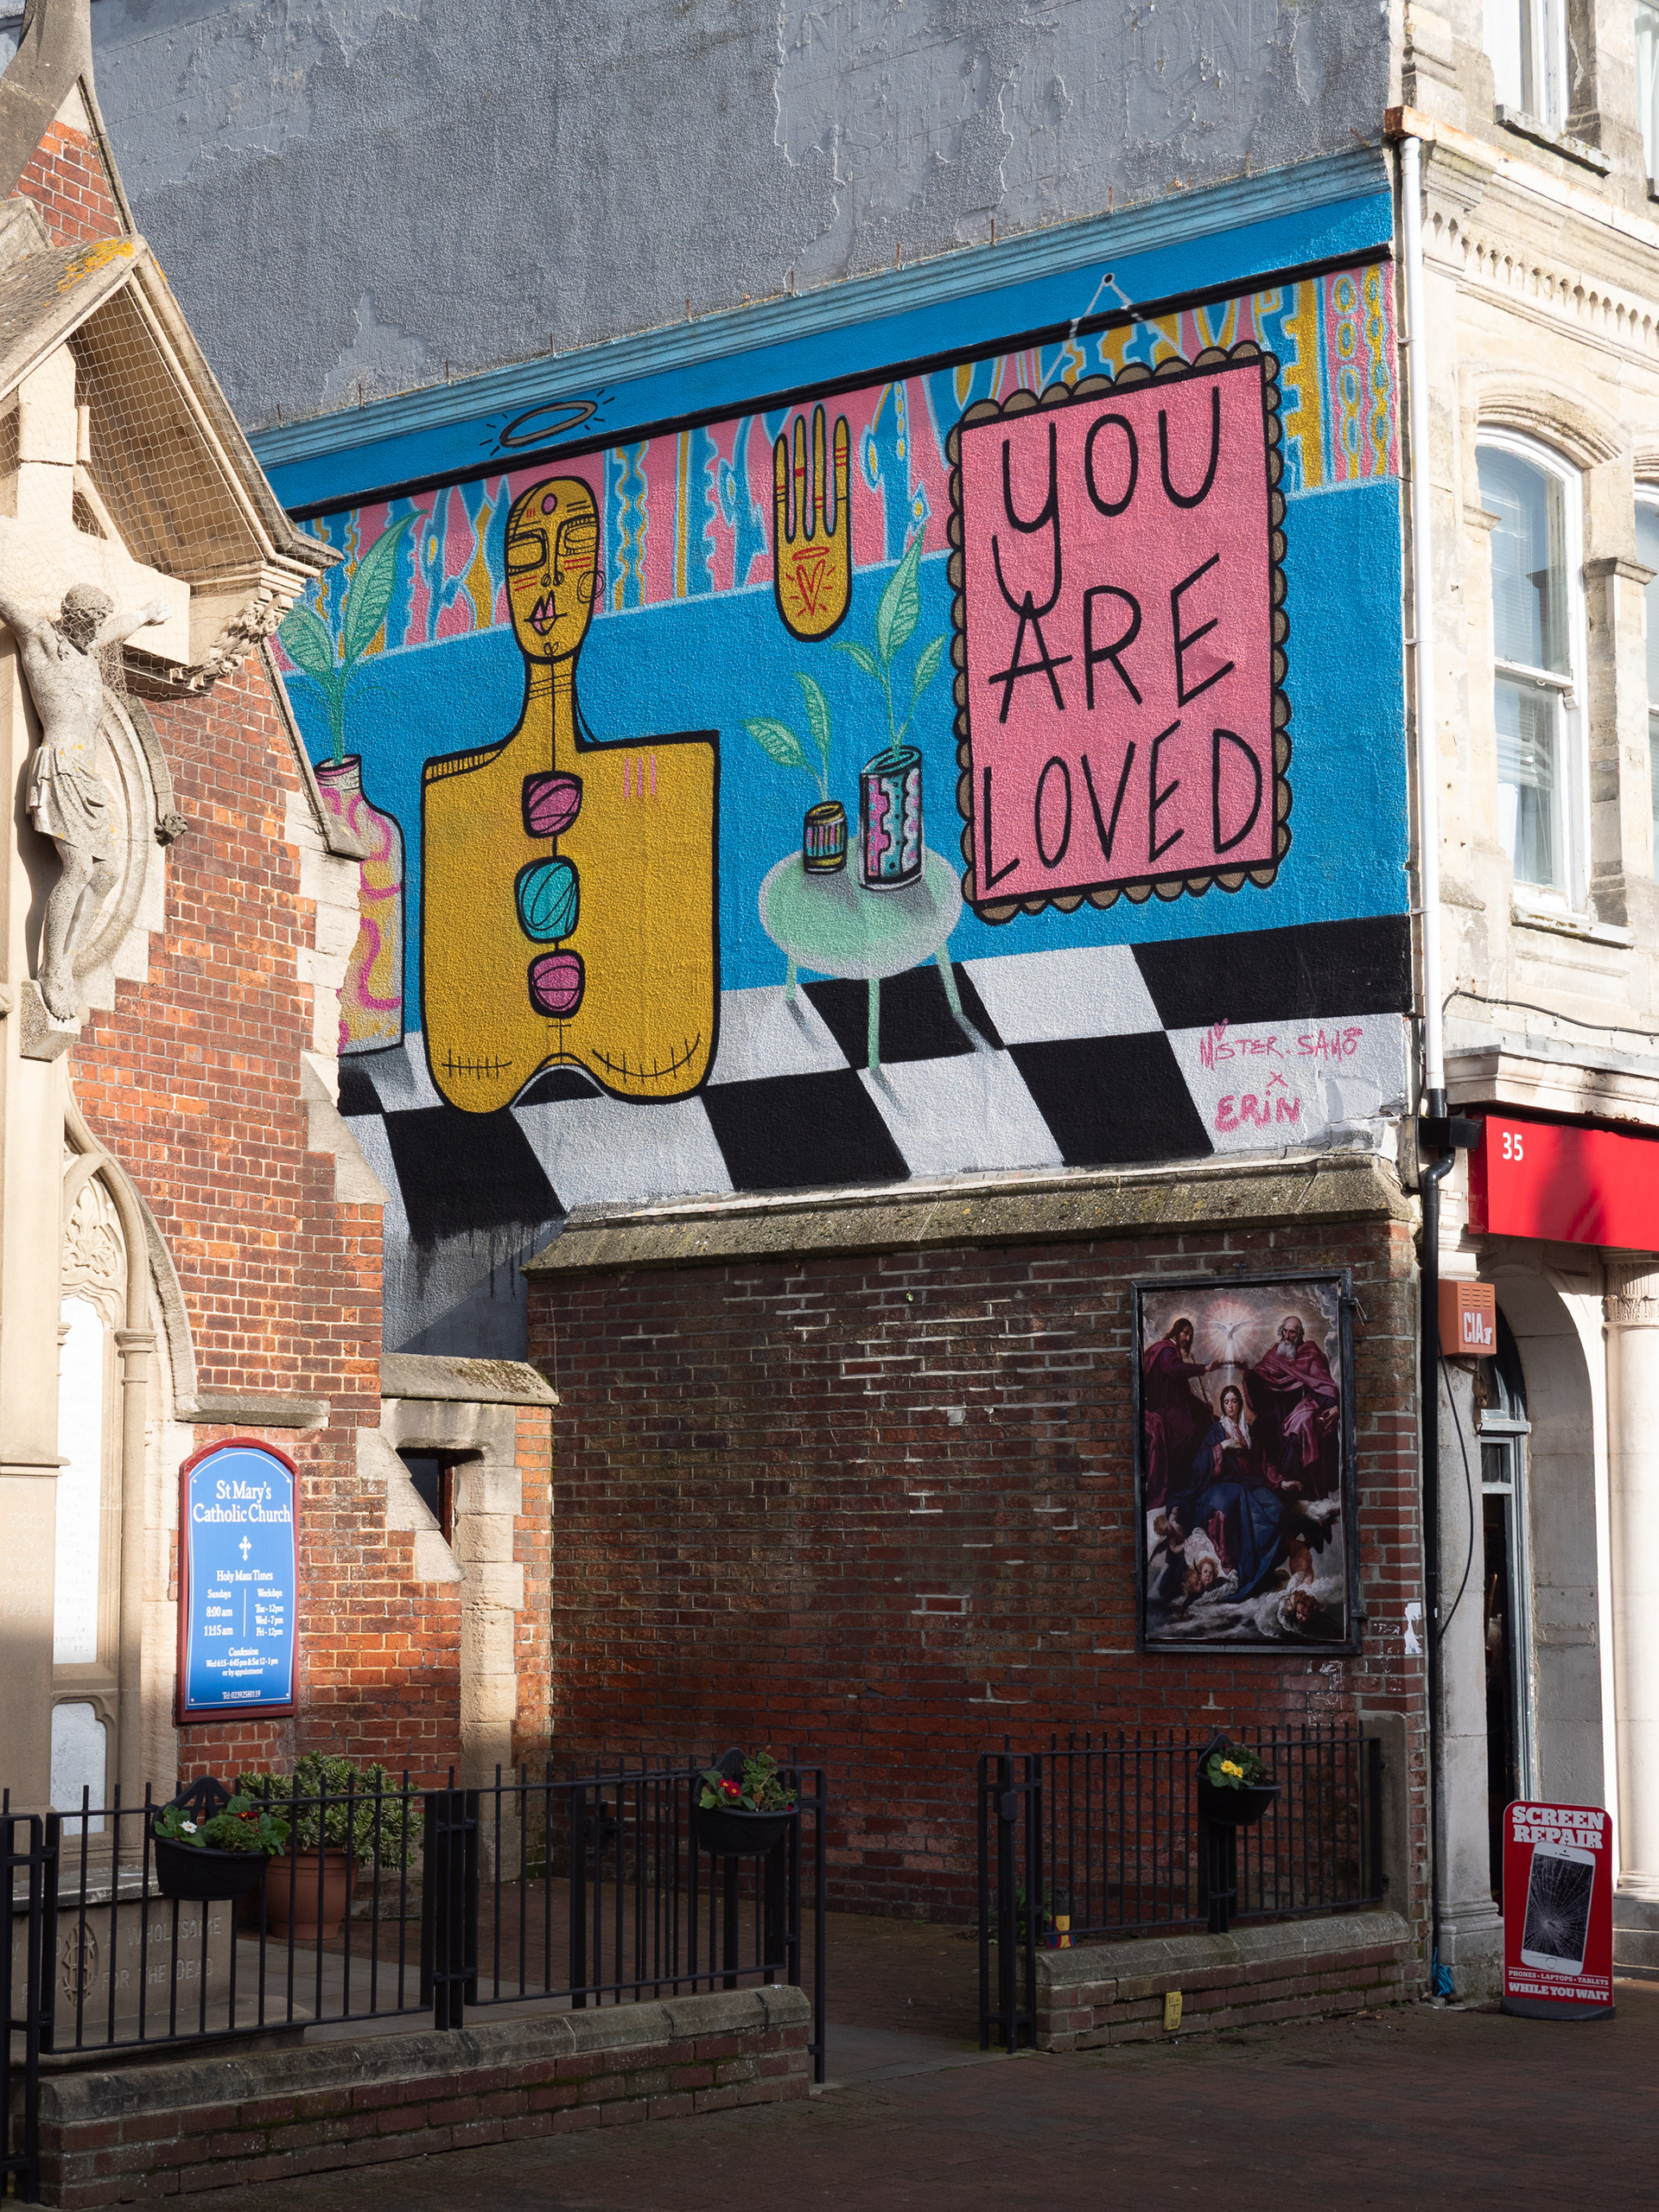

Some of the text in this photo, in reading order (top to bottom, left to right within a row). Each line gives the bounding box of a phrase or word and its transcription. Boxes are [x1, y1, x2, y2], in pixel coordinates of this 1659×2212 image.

[992, 385, 1220, 618] YOU
[988, 553, 1235, 723] ARE
[984, 719, 1263, 890] LOVED
[1502, 1132, 1523, 1161] 35
[216, 1479, 271, 1503] St Mary's
[194, 1503, 291, 1522] Catholic Church
[216, 1569, 273, 1583] Holy Mass Times
[207, 1588, 232, 1599] Sundays
[257, 1587, 283, 1599] Weekdays
[206, 1606, 221, 1618] 8:00
[228, 1647, 259, 1656] Confession
[234, 1668, 264, 1677] appointment
[1512, 1805, 1605, 1830] SCREEN
[1513, 1824, 1604, 1849] REPAIR
[127, 1916, 222, 1945] WHOLSOME
[138, 1963, 167, 1984] HE
[1541, 1974, 1573, 1982] LAPTOPS
[1577, 1977, 1609, 1986] TABLETS
[1508, 1982, 1609, 2001] WHILE YOU WAIT
